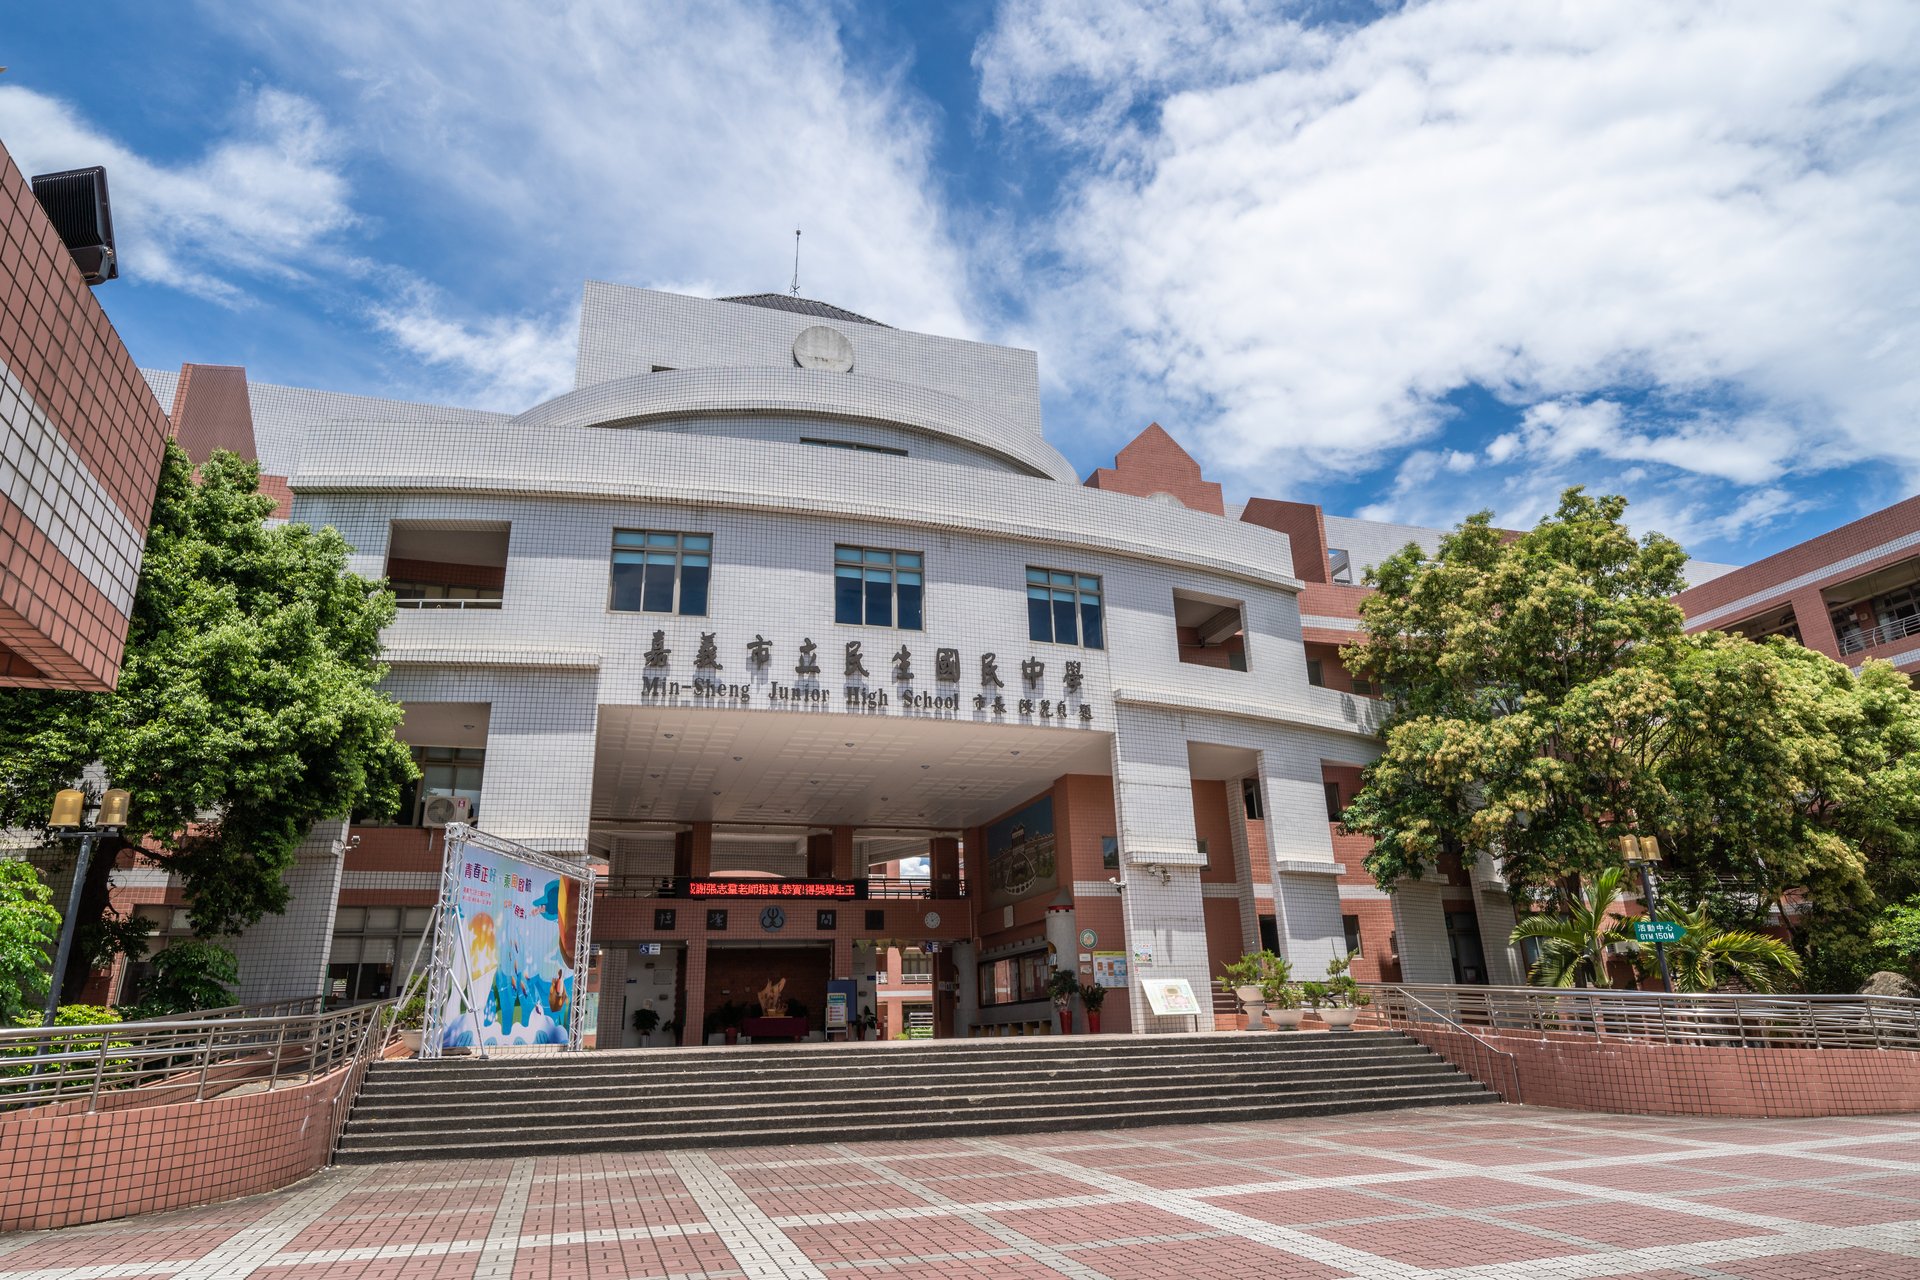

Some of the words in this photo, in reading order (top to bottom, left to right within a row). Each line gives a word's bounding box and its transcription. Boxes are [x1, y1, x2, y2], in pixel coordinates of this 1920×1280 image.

[643, 629, 1084, 694] 嘉義市立民生國民中學
[641, 676, 751, 701] Min-Sheng
[768, 681, 830, 703] Junior
[846, 686, 889, 709] High
[902, 689, 960, 711] School
[465, 863, 496, 883] 青春正好
[1638, 924, 1673, 932] 活動中心
